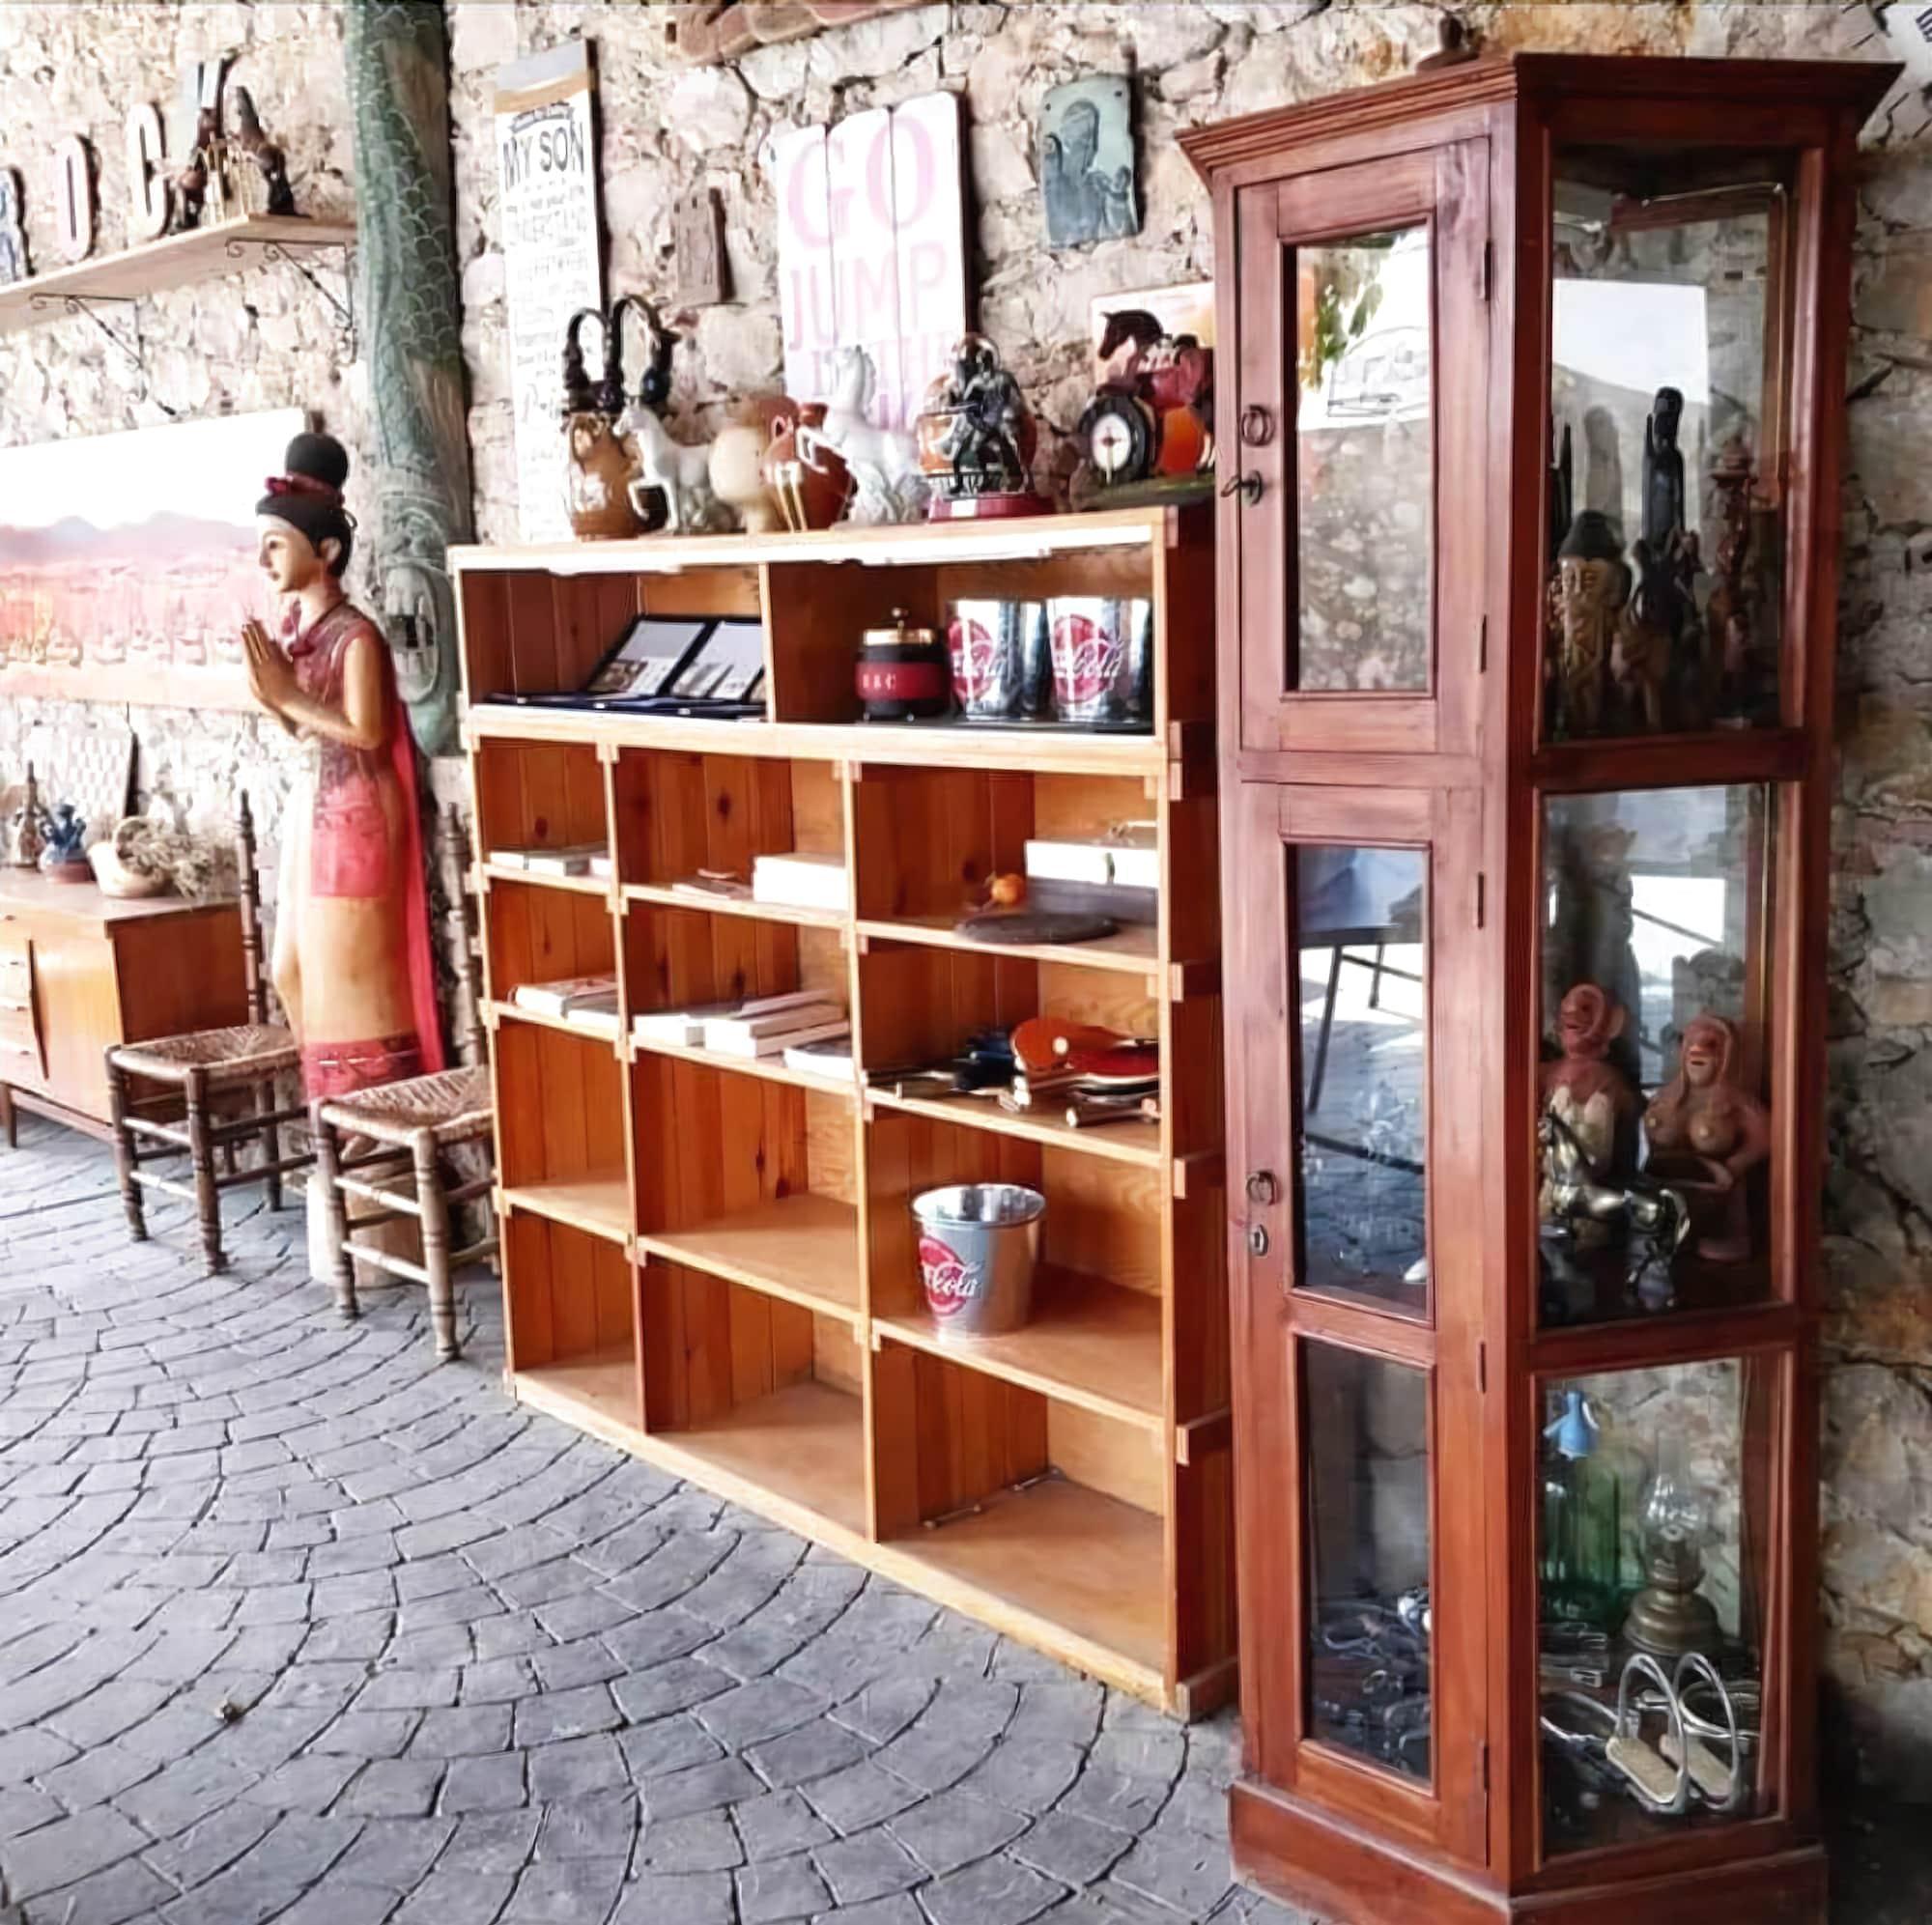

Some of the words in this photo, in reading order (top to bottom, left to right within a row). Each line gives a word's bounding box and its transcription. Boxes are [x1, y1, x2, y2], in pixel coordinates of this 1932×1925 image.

[503, 136, 533, 191] MY
[539, 123, 584, 174] SON
[786, 114, 937, 247] GO
[788, 241, 949, 352] JUMP
